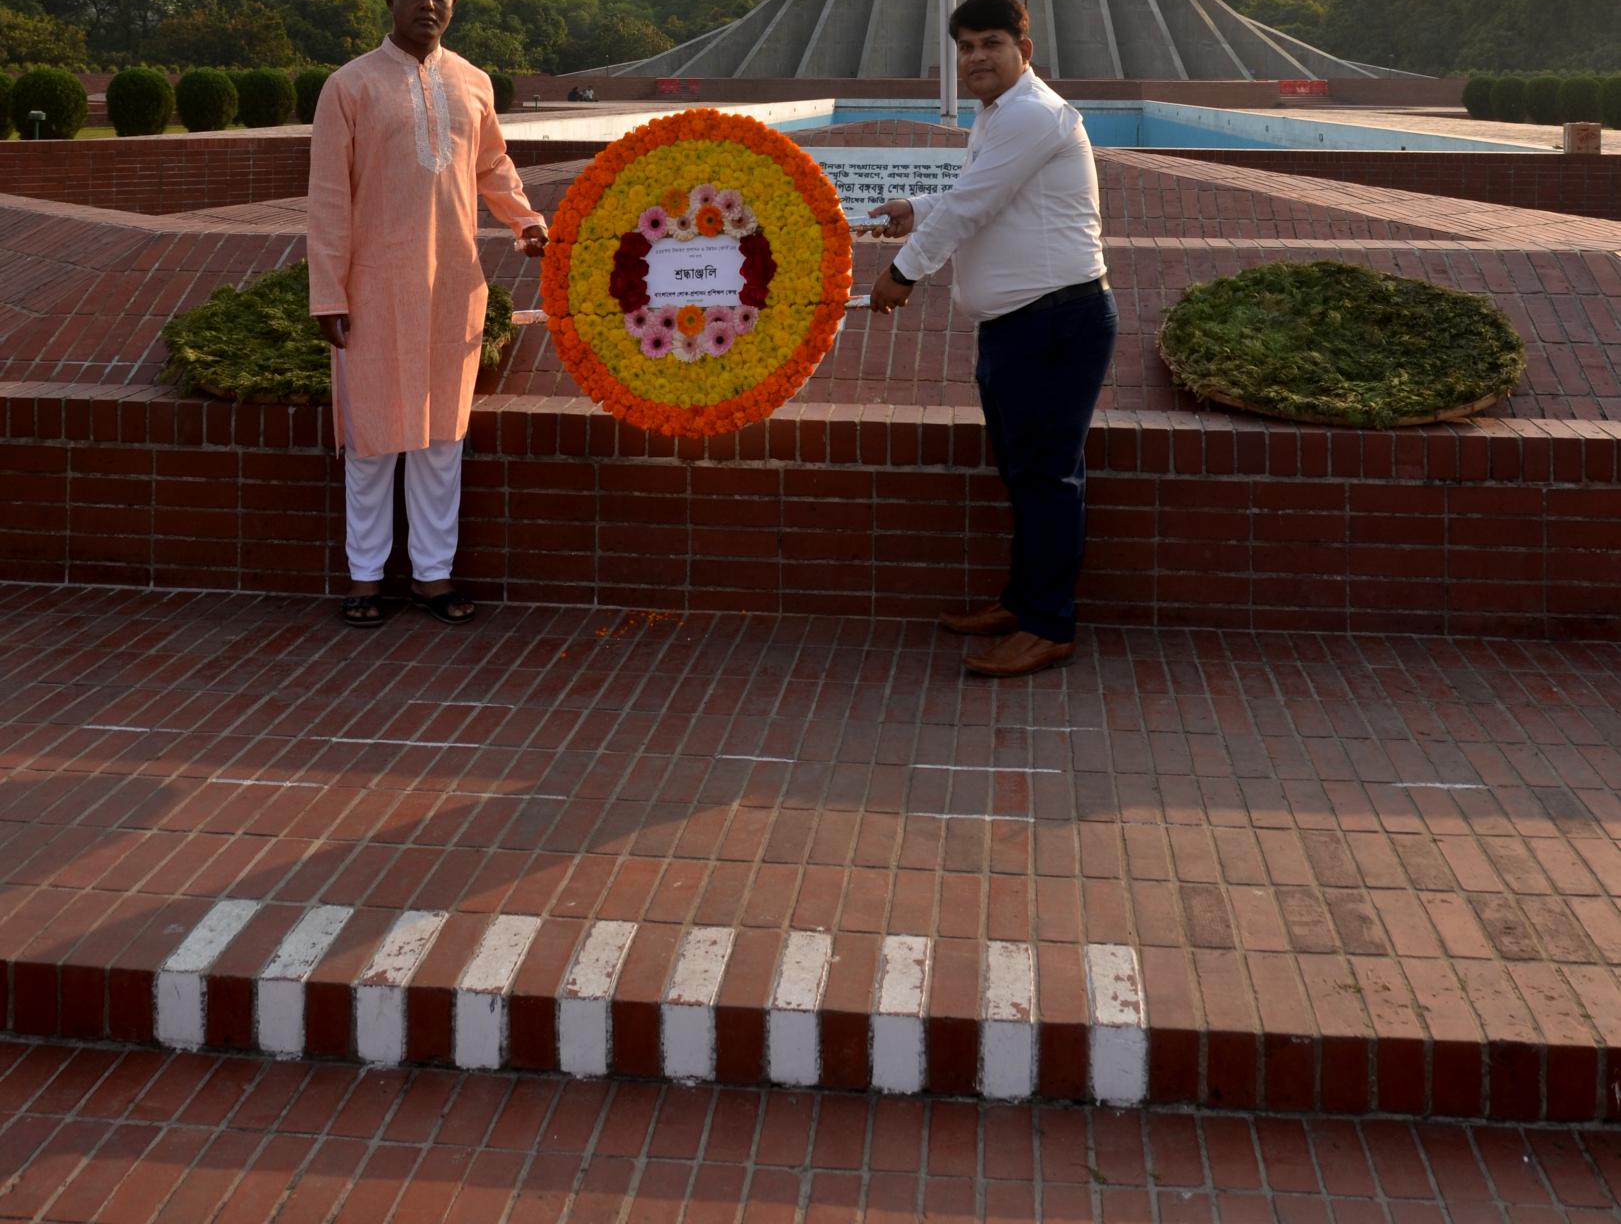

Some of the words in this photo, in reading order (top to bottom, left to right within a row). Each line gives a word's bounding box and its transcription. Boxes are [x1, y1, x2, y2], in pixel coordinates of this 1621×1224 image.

[912, 170, 938, 179] বিজয়
[858, 183, 886, 197] বঙ্গবন্ধু
[888, 182, 906, 194] শেখ
[909, 181, 938, 196] মুজিবুর
[674, 264, 717, 280] শ্রদ্ধাঞ্জলি
